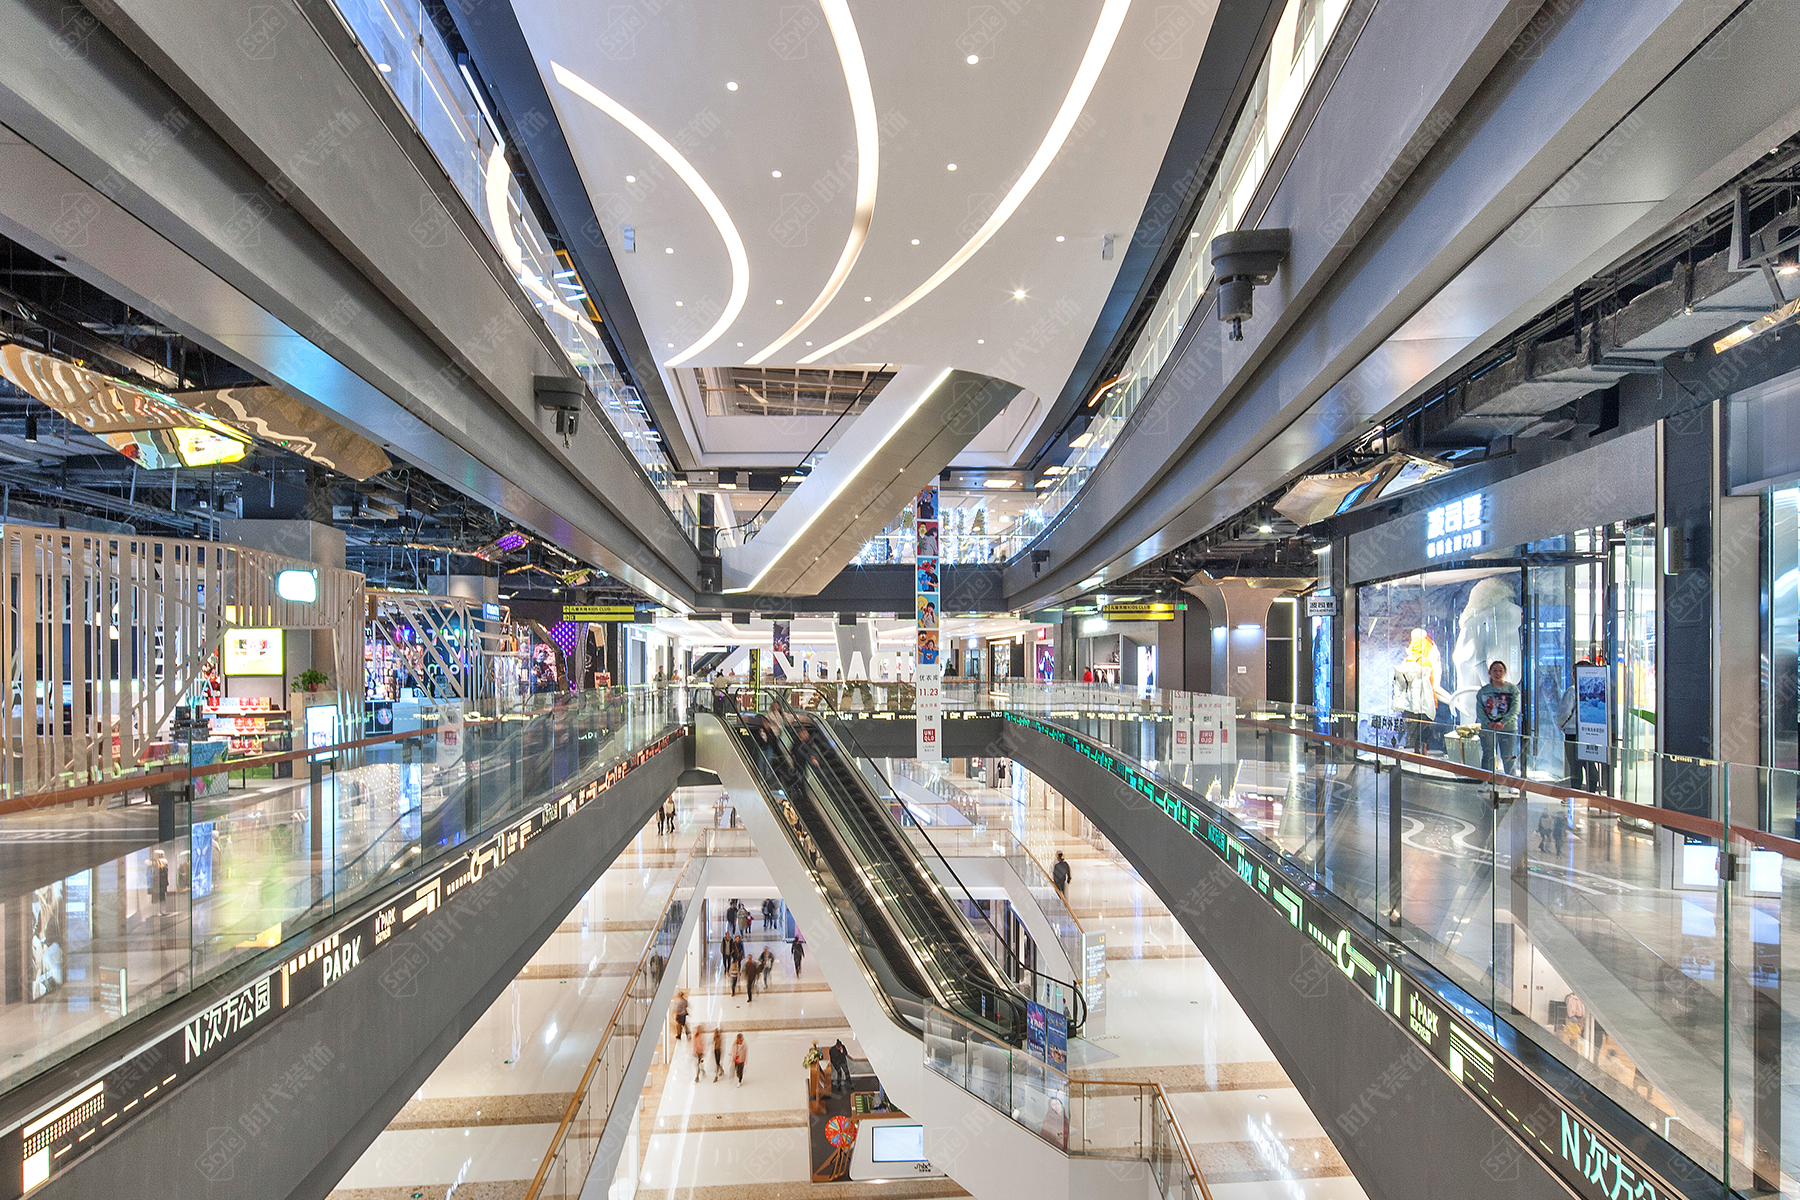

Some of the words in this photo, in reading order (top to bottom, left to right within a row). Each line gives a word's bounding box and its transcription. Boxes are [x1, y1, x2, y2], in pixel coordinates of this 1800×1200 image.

[919, 674, 939, 682] 优衣库
[919, 688, 938, 696] 11.23
[322, 934, 362, 988] PARK
[184, 976, 271, 1065] N次方公园
